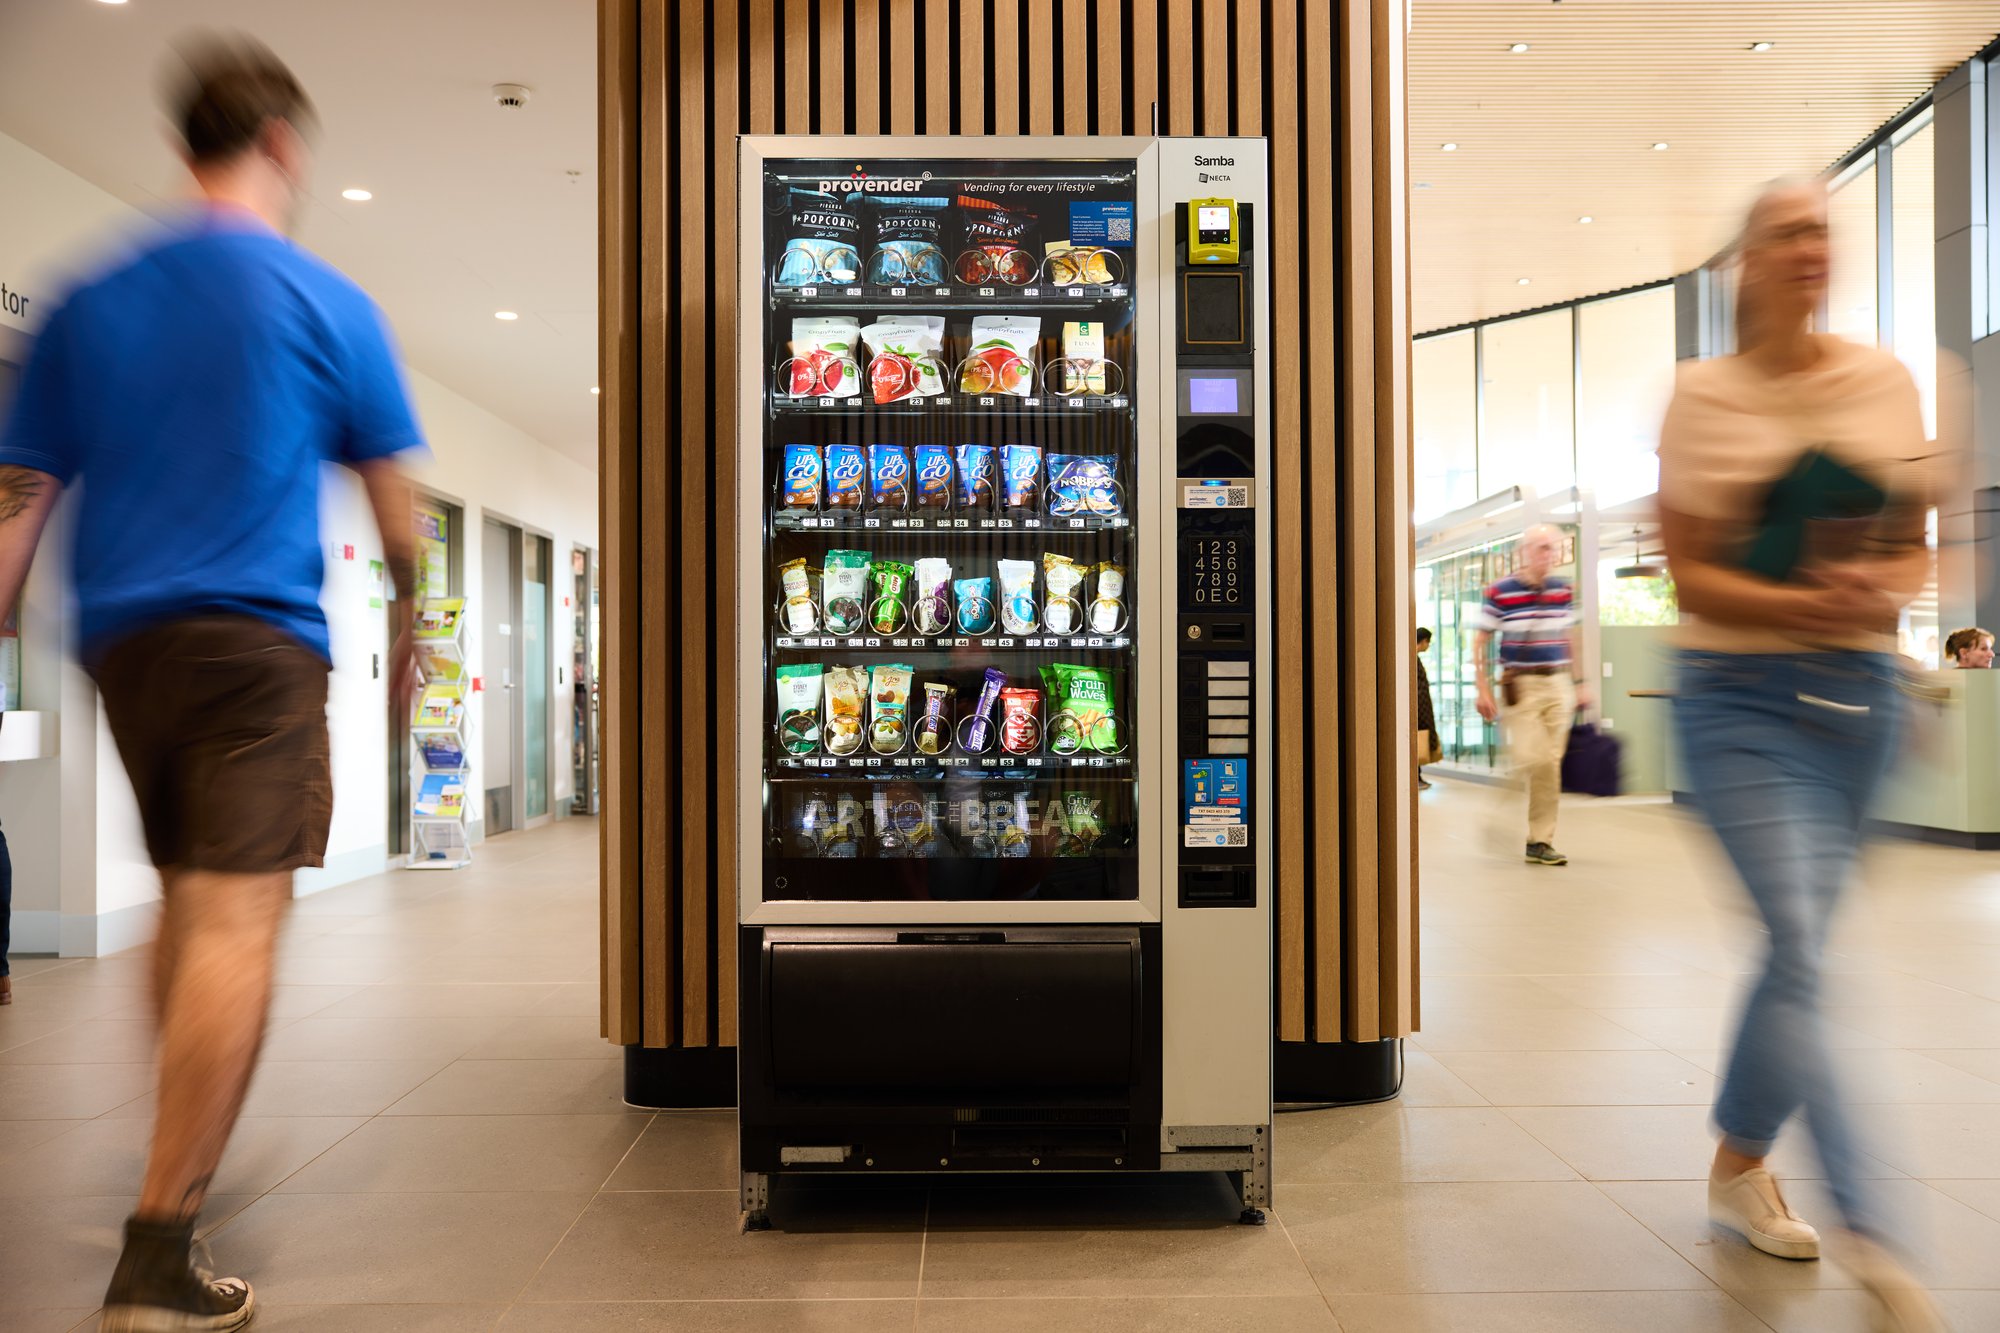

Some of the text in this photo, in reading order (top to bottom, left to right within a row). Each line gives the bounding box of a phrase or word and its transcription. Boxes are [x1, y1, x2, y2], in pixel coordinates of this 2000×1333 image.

[1194, 155, 1235, 167] Samba
[818, 178, 924, 197] provender
[963, 182, 1096, 194] Vending for every lifestyle
[803, 213, 855, 228] POPCORN
[885, 219, 936, 229] POPCORN
[1, 282, 30, 318] tor
[788, 463, 820, 479] GO
[833, 463, 863, 479] GO
[878, 463, 907, 480] GO
[920, 463, 951, 480] GO
[971, 463, 995, 478] GO
[1012, 464, 1039, 480] GO
[1211, 541, 1221, 554] 2
[1226, 541, 1236, 554] 3
[1195, 557, 1237, 570] 4 5 6
[891, 575, 899, 592] MILO
[1195, 573, 1237, 586] 7 8 9
[1195, 588, 1238, 602] 0 E C
[1070, 676, 1106, 690] Grain
[1070, 687, 1106, 701] Waves
[802, 800, 1102, 837] ART OF THE BREAK
